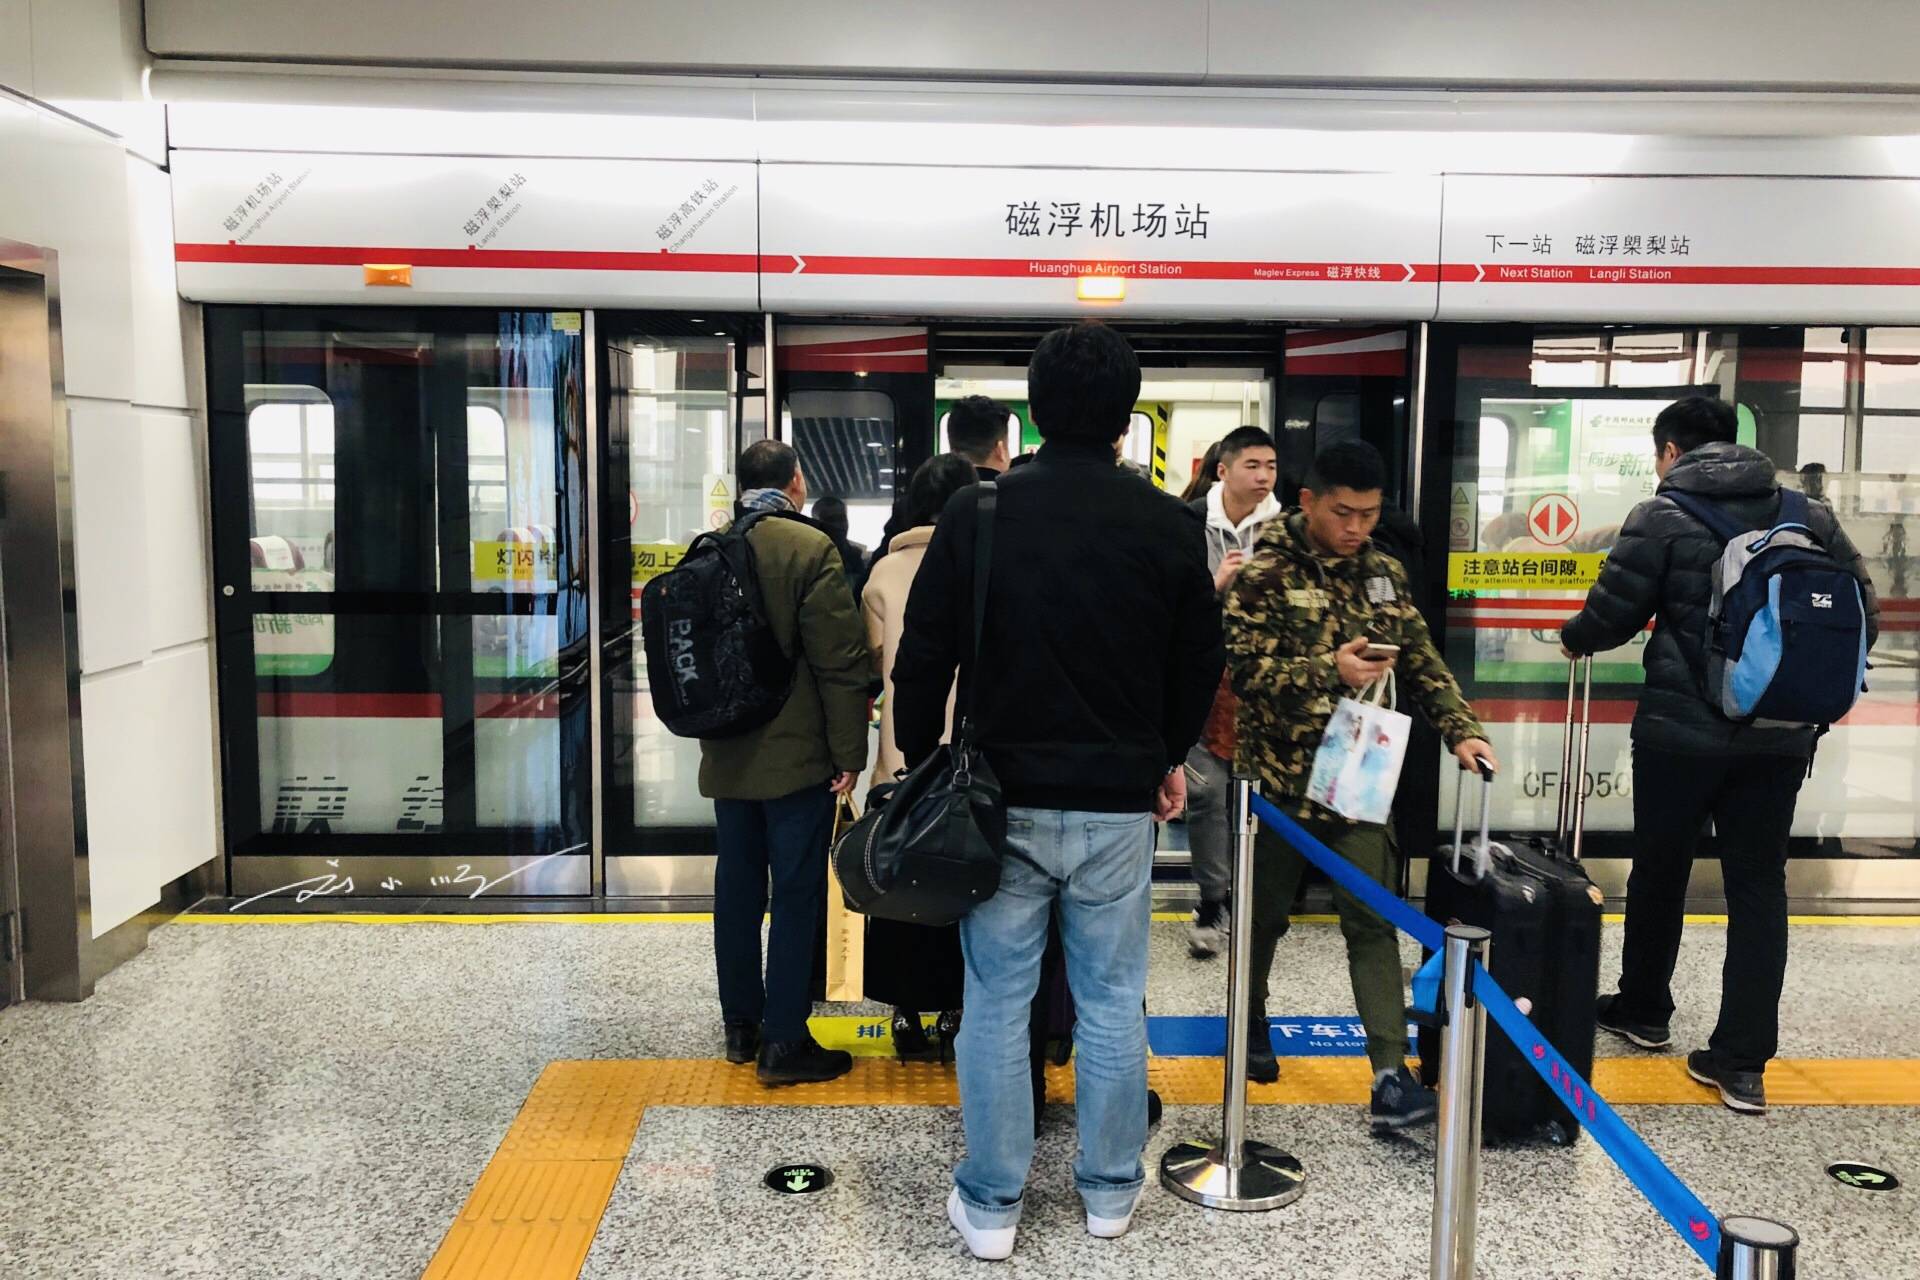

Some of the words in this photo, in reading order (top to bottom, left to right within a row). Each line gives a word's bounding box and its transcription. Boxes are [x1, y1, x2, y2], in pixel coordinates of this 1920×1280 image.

[656, 178, 719, 240] 磁浮高铁站
[1005, 201, 1210, 239] 磁浮机场站
[1485, 234, 1552, 255] 下一站
[1029, 262, 1092, 276] Huanghua
[1095, 263, 1136, 277] Airport
[1139, 264, 1182, 275] Station
[1254, 269, 1284, 278] Maglev
[1286, 269, 1320, 278] Express
[1327, 265, 1381, 279] 磁浮快线
[1500, 267, 1528, 278] Next
[1531, 267, 1573, 279] Station
[1590, 268, 1626, 281] Langli
[1629, 269, 1672, 280] Station
[1464, 559, 1608, 576] 注意站台间隙，
[1463, 577, 1479, 585] Pay
[1484, 576, 1524, 584] attention
[1309, 1040, 1333, 1048] No
